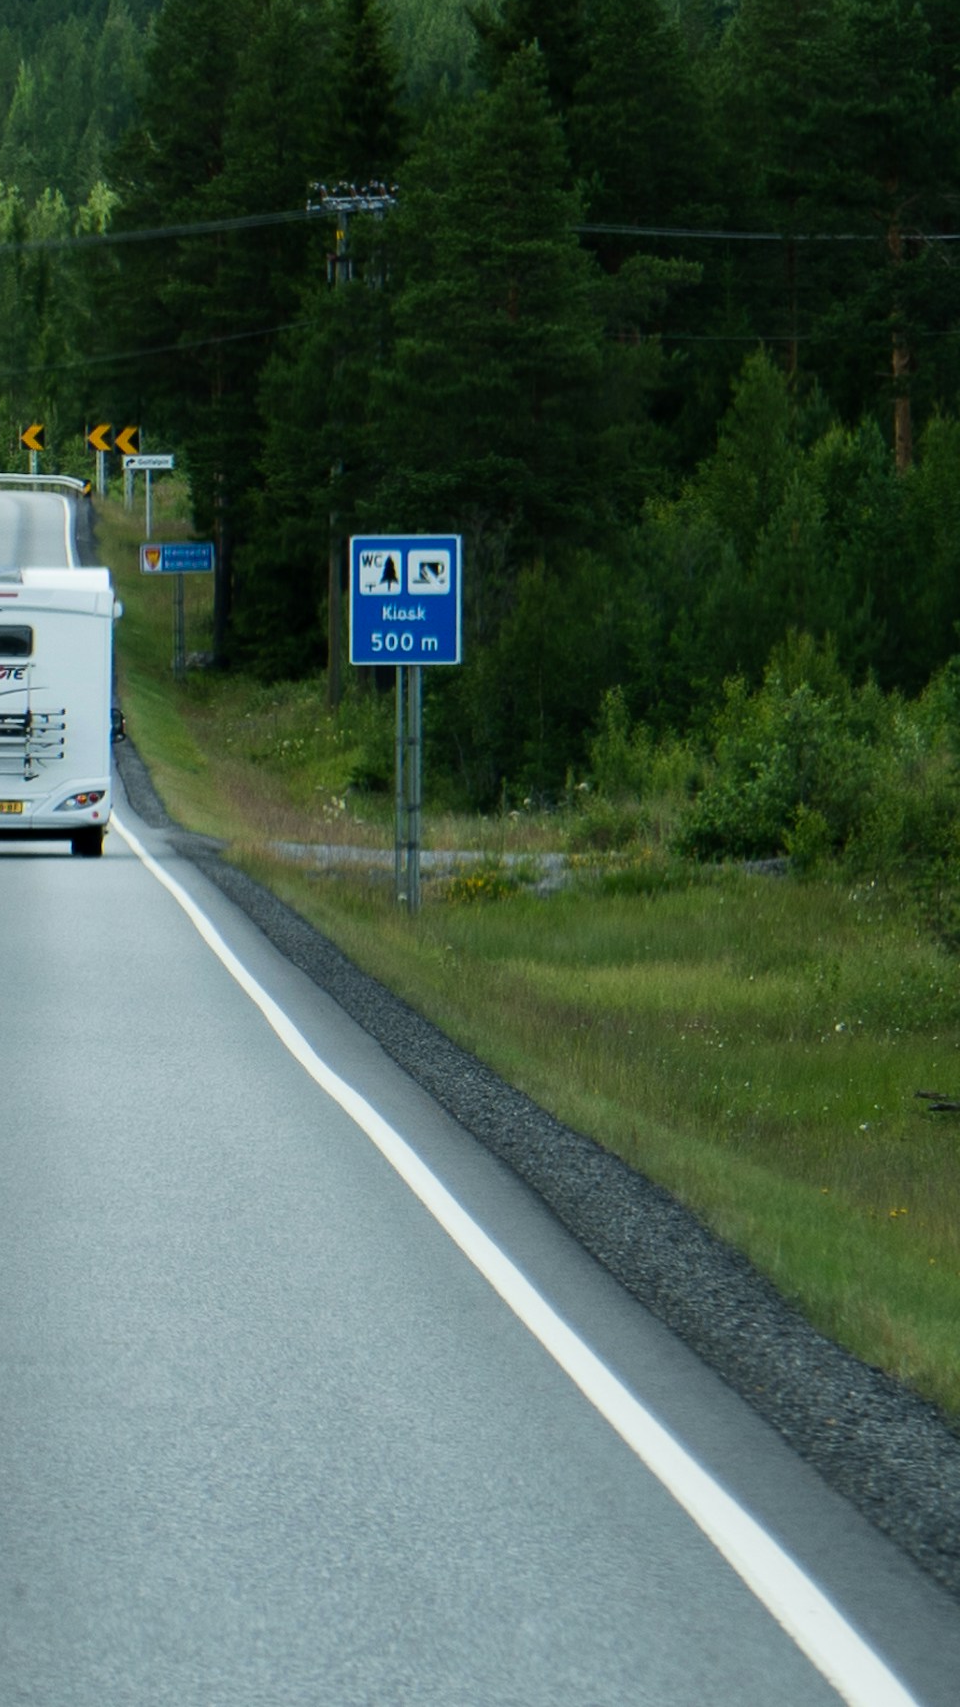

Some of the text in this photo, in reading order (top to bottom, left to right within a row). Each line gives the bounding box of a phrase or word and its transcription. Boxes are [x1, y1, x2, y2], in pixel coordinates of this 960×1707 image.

[361, 554, 383, 568] WC
[381, 604, 427, 621] Kiosk
[371, 633, 439, 652] 500 m
